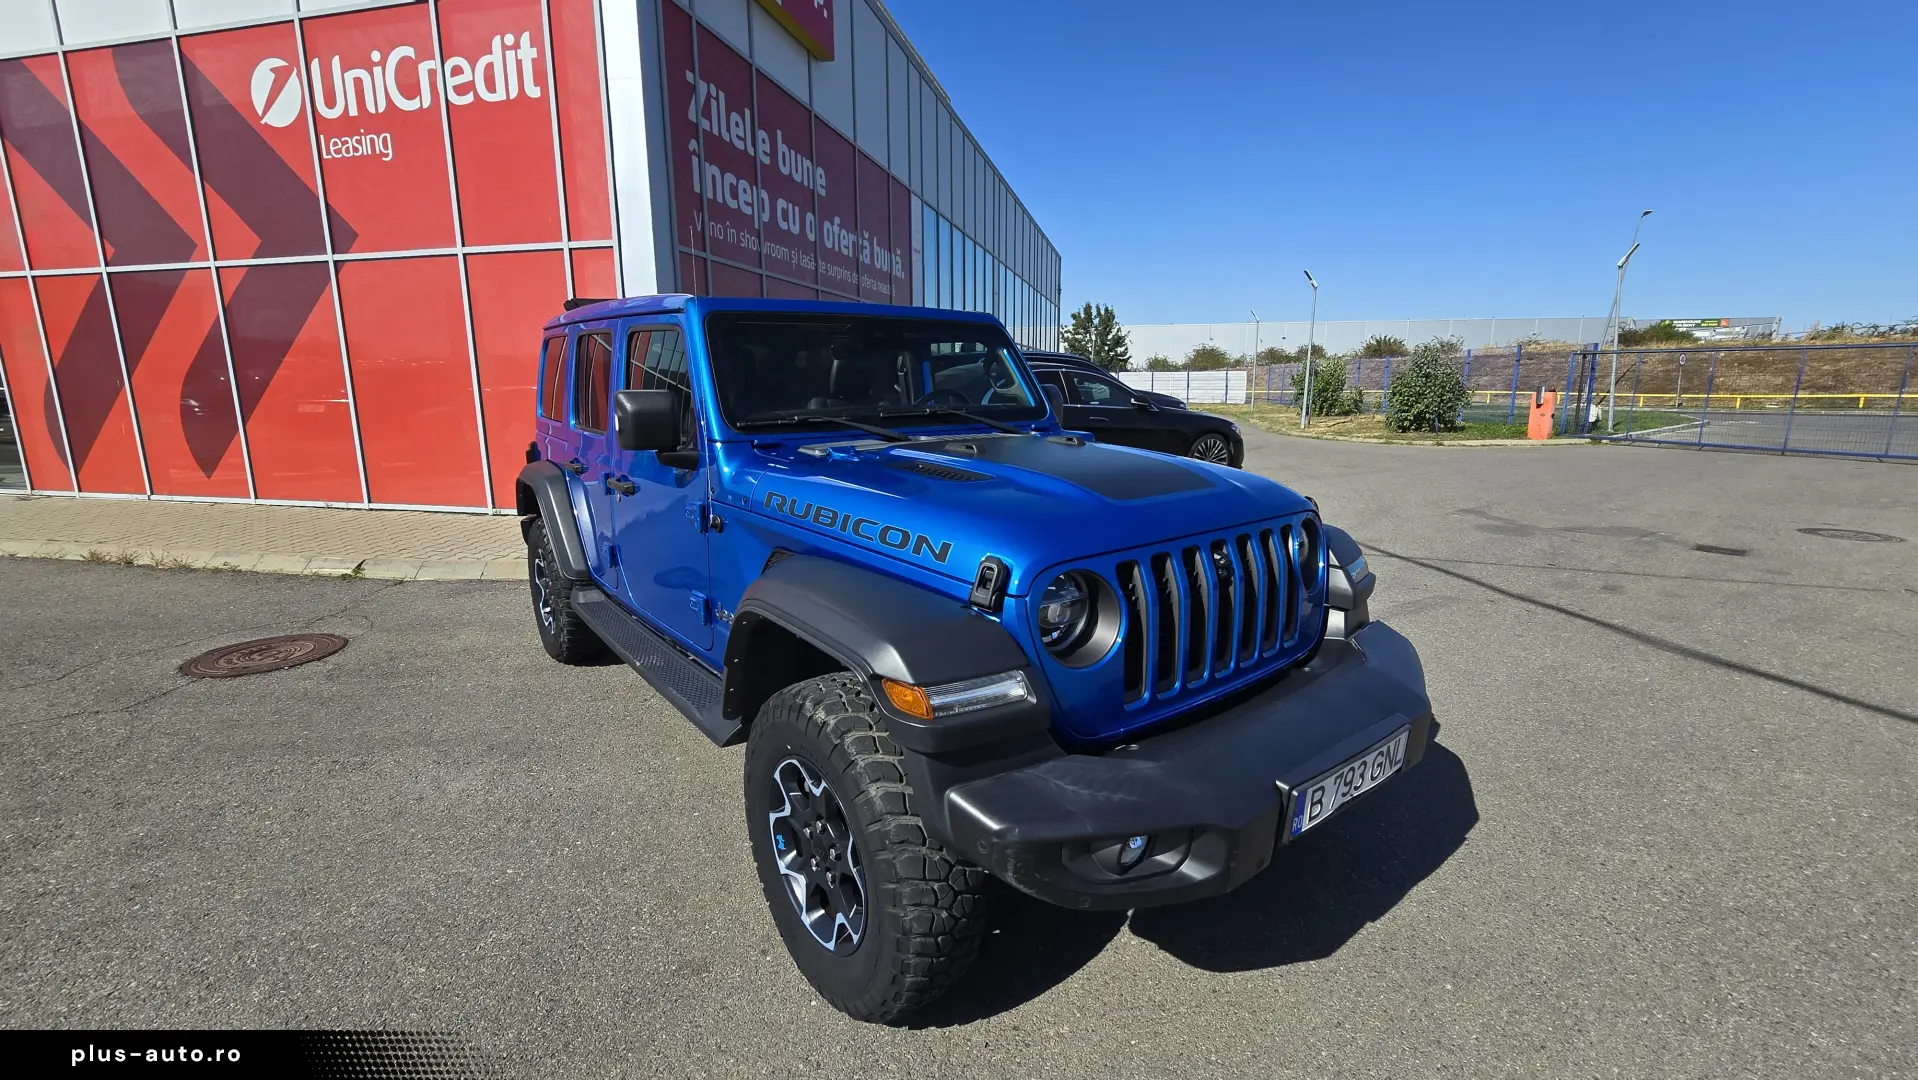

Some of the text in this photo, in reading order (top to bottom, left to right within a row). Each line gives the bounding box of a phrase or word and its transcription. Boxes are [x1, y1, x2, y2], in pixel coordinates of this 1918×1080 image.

[311, 31, 541, 119] UniCredit
[320, 128, 393, 161] Leasing
[685, 69, 826, 197] Zilele bune
[688, 138, 770, 230] încep
[777, 198, 800, 235] cu
[805, 211, 817, 242] o
[693, 209, 724, 240] Vno
[725, 221, 737, 245] în
[877, 281, 896, 297] noastă
[763, 490, 954, 565] RUBICON
[1292, 814, 1304, 832] RO
[1307, 737, 1402, 824] B 793 GNL
